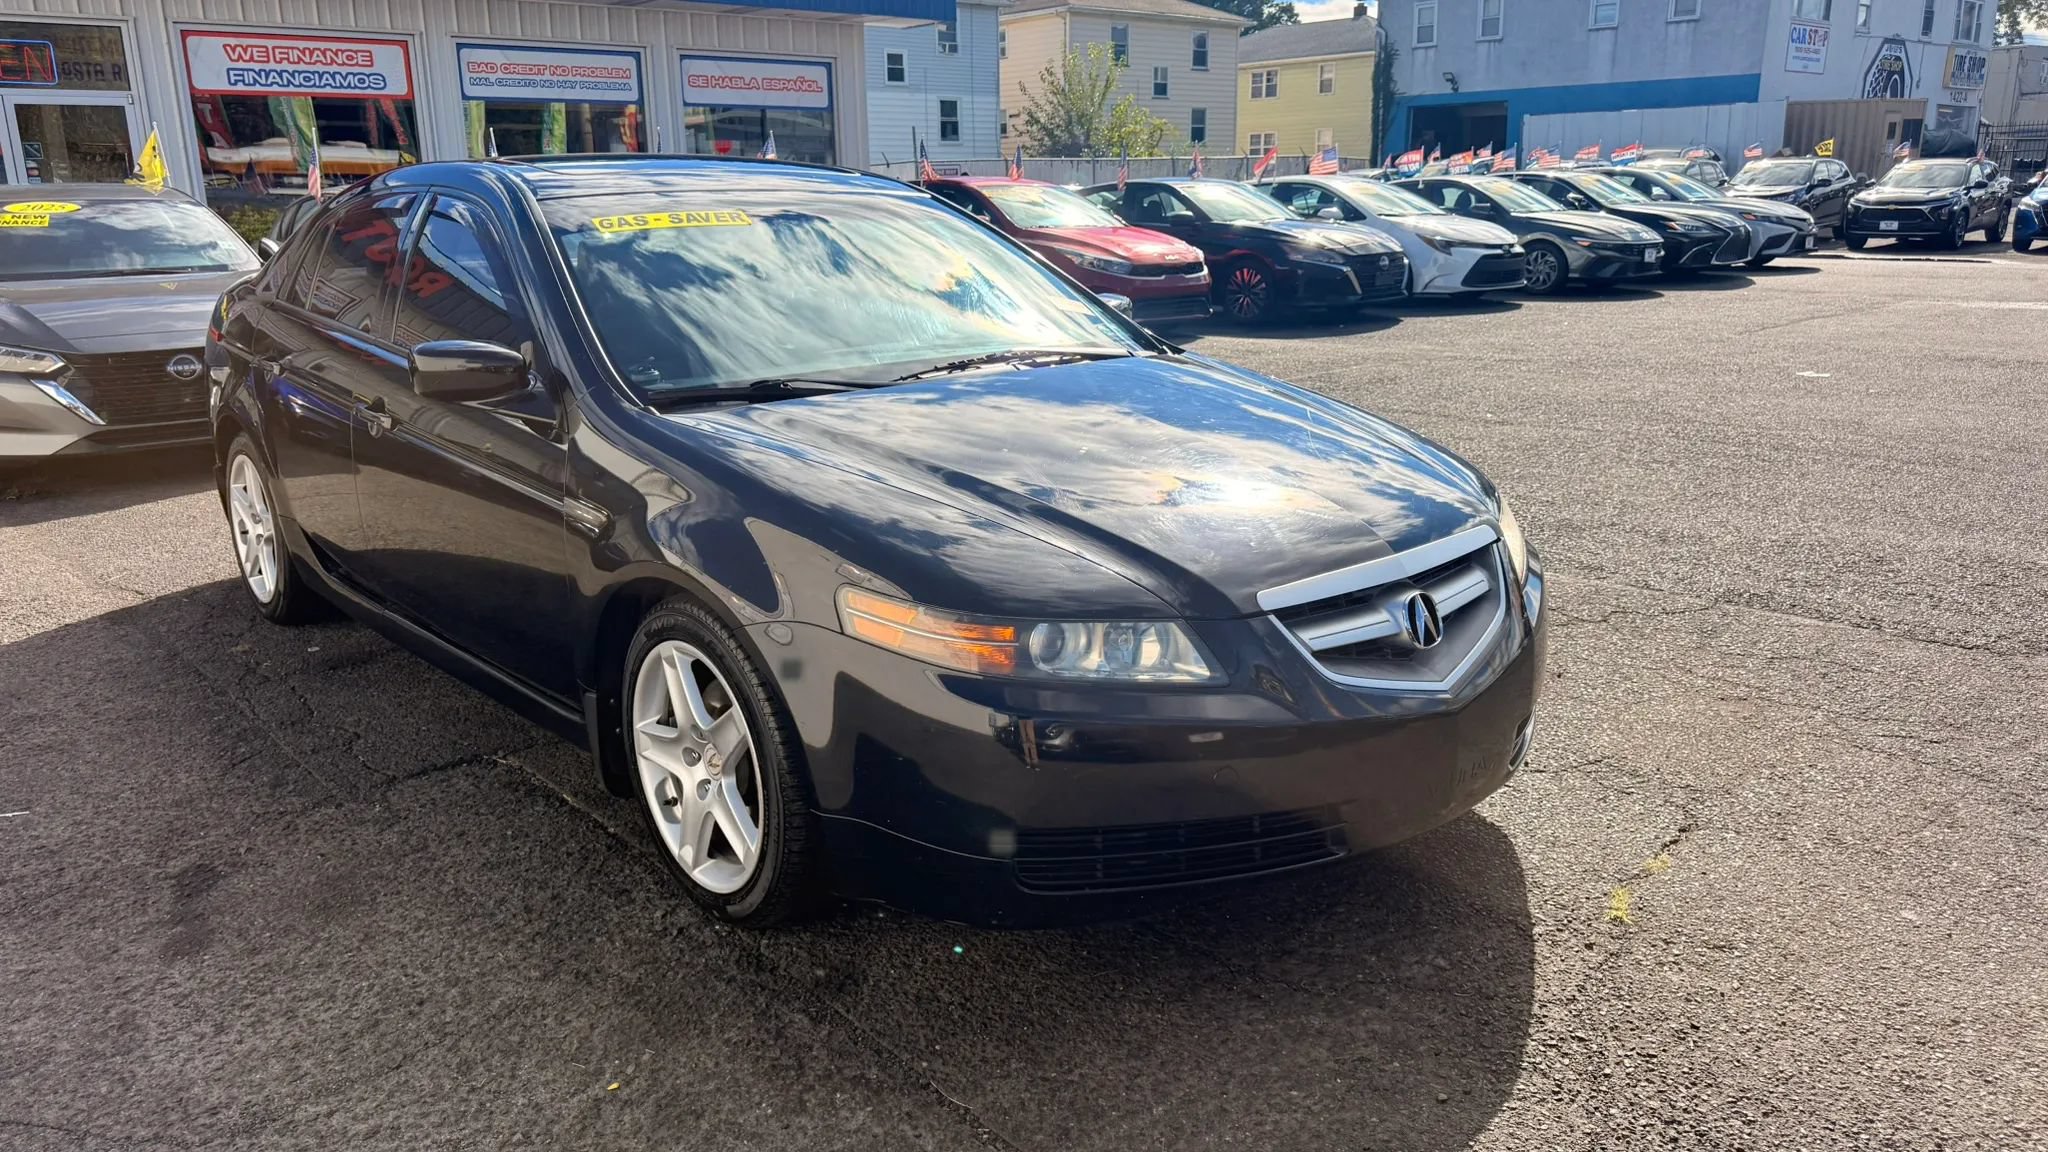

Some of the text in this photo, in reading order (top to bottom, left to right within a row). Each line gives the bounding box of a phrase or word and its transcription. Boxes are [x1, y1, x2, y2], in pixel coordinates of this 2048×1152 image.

[1790, 26, 1807, 44] CAR
[223, 43, 374, 67] WE FINANCE
[1952, 54, 1986, 74] TIRE SHOP
[227, 68, 387, 90] FINANCIAMOS
[467, 62, 631, 79] BAD CREDIT NO PROBLEM
[469, 77, 632, 91] MAL CREDITO NO HAY PROBLEMA
[688, 75, 823, 92] SE HABLA ESPAÑOL
[599, 215, 649, 229] GAS
[668, 211, 745, 225] SAVER
